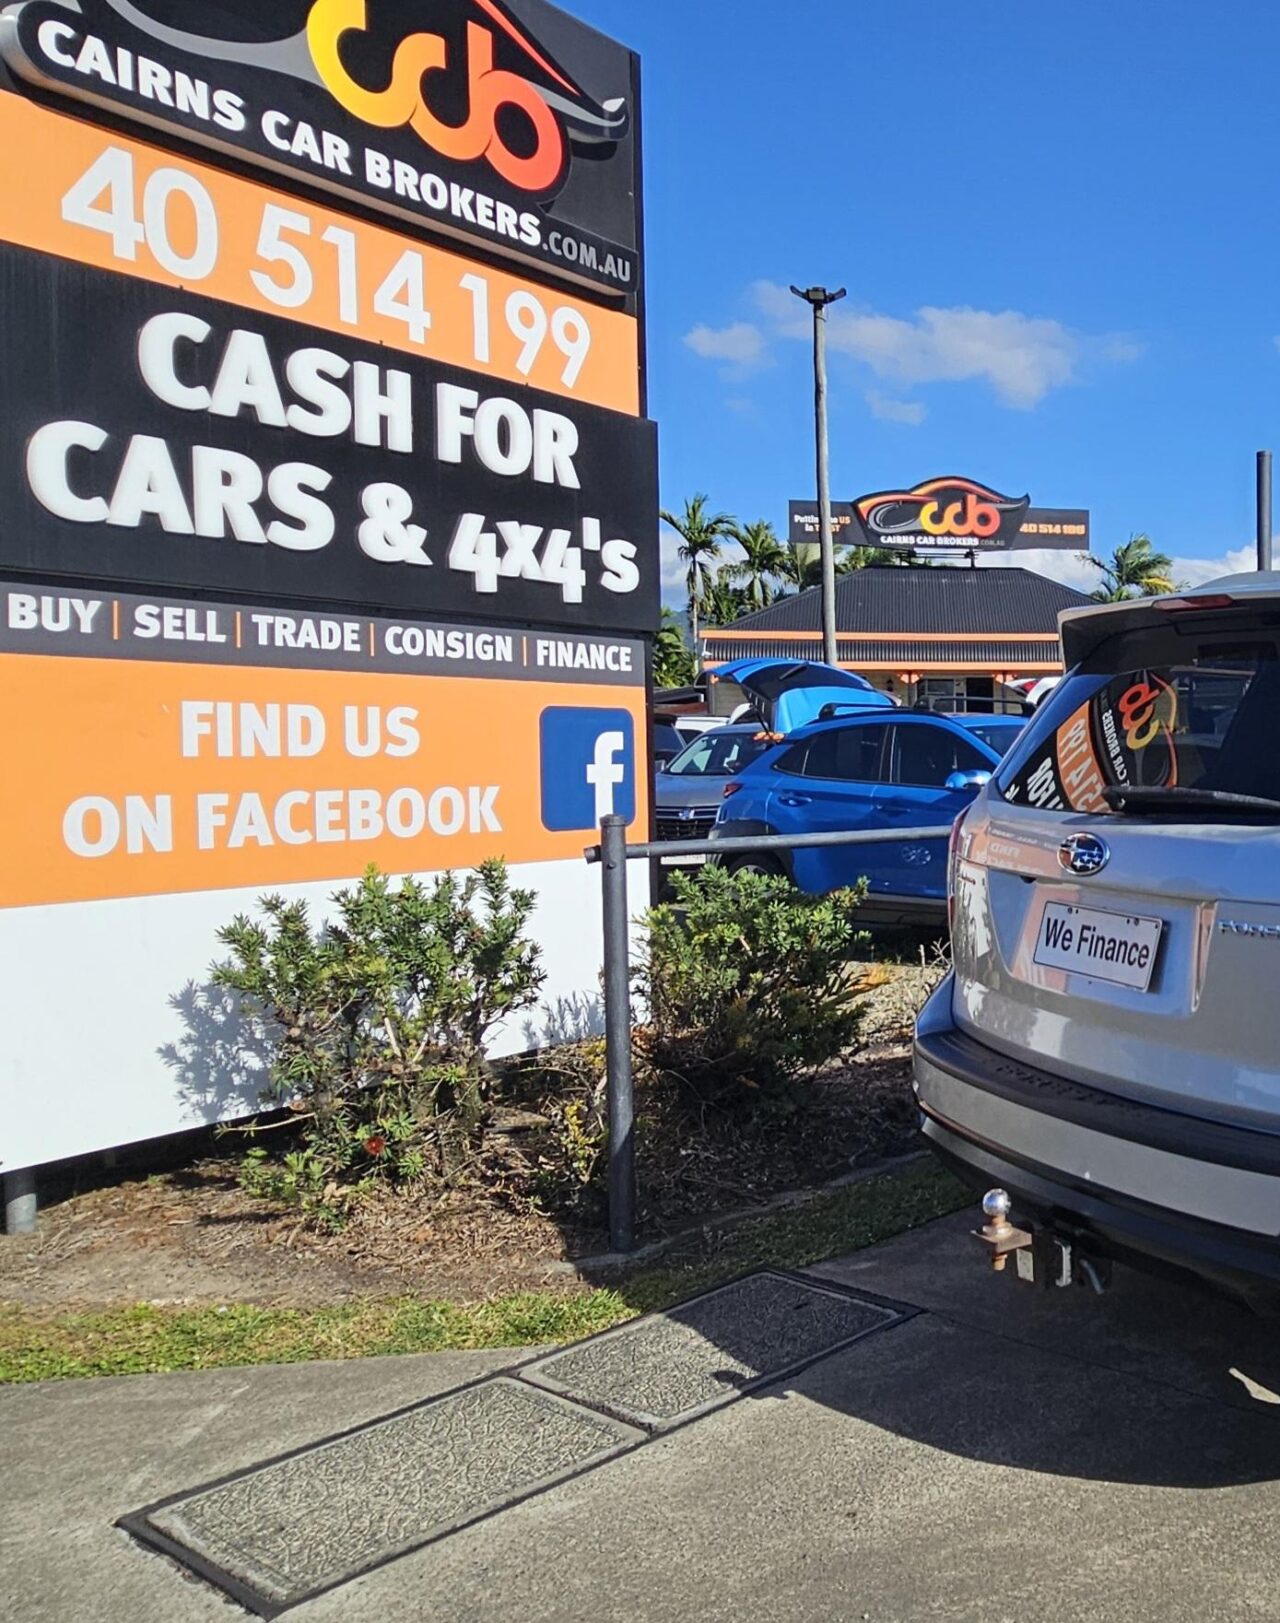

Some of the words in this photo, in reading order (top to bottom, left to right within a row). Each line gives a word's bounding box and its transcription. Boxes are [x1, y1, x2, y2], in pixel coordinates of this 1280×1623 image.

[37, 20, 247, 132] CAIRNS
[262, 109, 351, 177] CAR
[61, 146, 219, 280] 40
[249, 203, 431, 344] 514
[458, 273, 591, 389] 199
[138, 312, 413, 453] CASH
[435, 381, 581, 490] FOR
[26, 420, 335, 551] CARS
[358, 482, 433, 565] &
[1019, 523, 1038, 533] 40
[1038, 523, 1061, 534] 514
[880, 535, 915, 545] CAIRNS
[916, 536, 935, 545] CAR
[8, 592, 103, 634] BUY
[133, 604, 226, 643] SELL
[251, 614, 360, 653] TRADE
[384, 625, 513, 663] CONSIGN
[536, 638, 632, 672] FINANCE
[181, 700, 326, 758] FIND
[344, 706, 420, 757] US
[62, 793, 172, 858] ON
[196, 785, 503, 850] FACEBOOK
[1046, 917, 1073, 951] We
[1077, 933, 1149, 968] Finance
